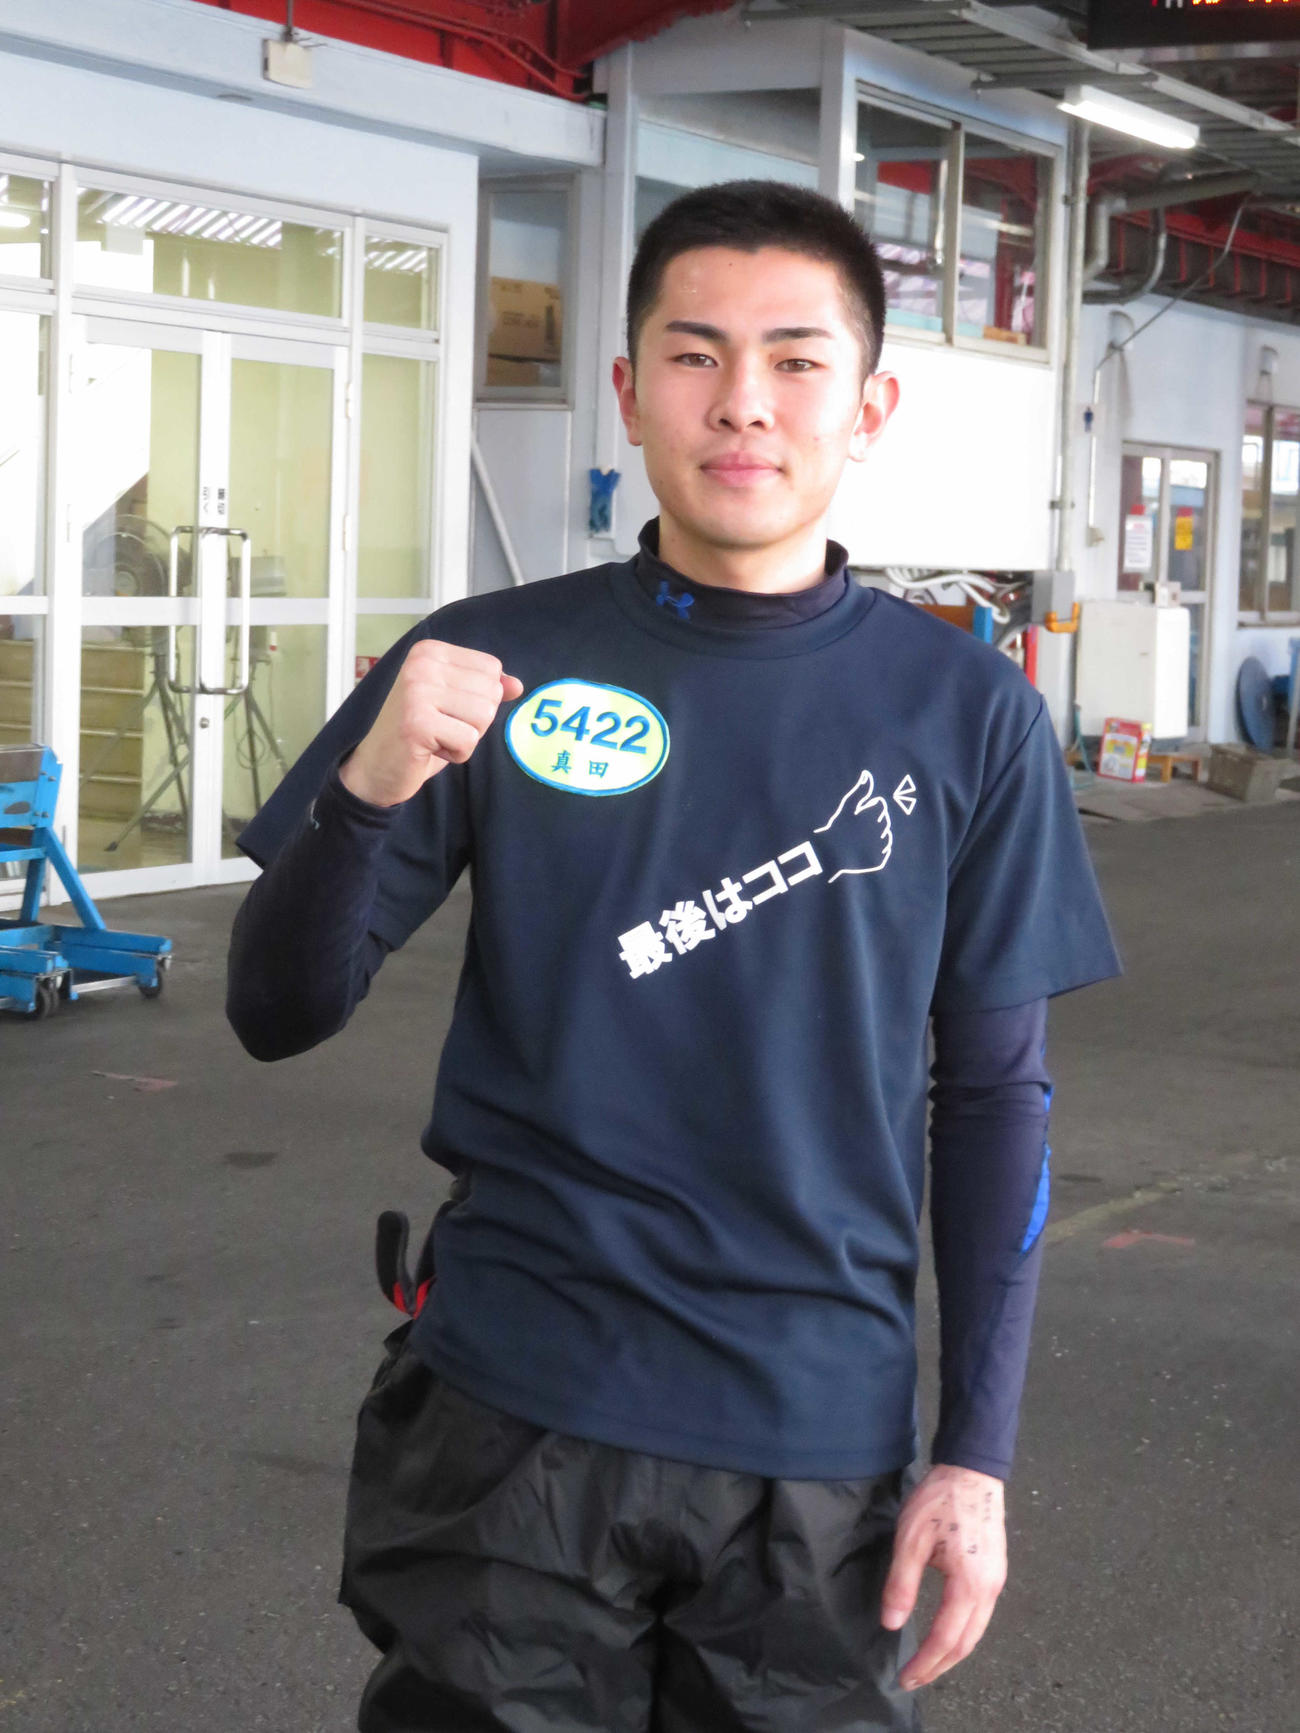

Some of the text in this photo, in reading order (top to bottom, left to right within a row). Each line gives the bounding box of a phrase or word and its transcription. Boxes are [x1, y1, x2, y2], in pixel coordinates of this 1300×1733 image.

[531, 699, 650, 754] 5422
[552, 750, 608, 778] 真田
[618, 841, 823, 979] 最後はココ
